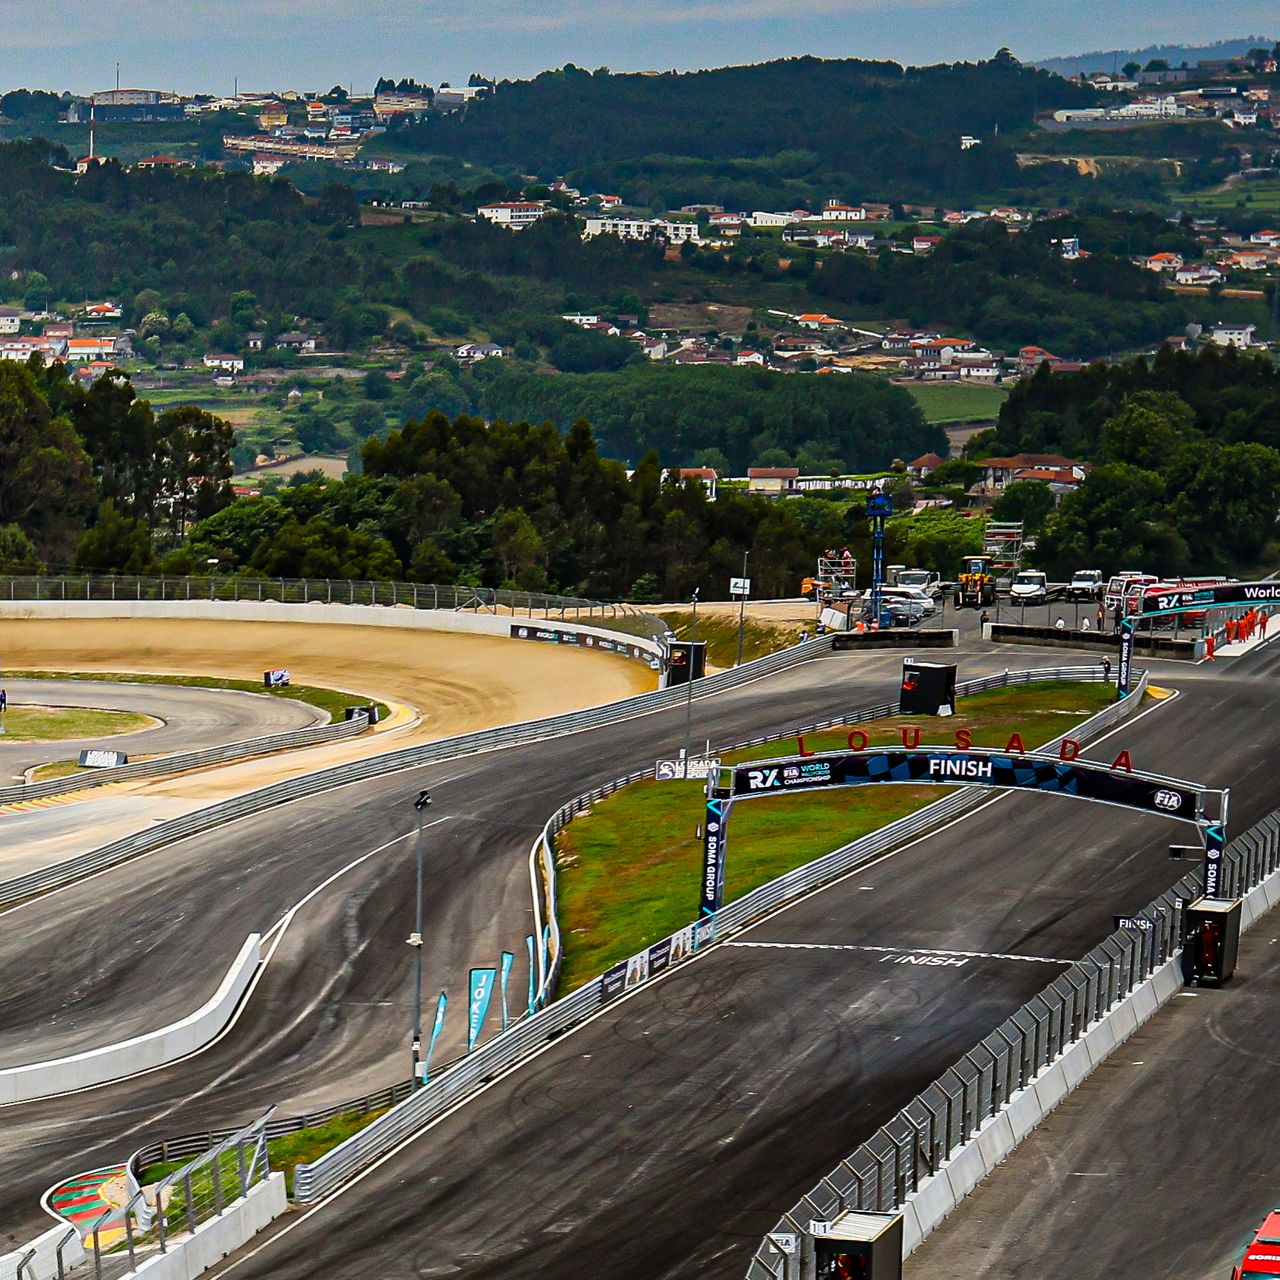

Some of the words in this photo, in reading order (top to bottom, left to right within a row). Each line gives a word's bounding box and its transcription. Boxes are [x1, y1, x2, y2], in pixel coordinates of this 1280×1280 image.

[1158, 594, 1180, 609] RX
[797, 727, 1133, 773] LOUSADA
[783, 768, 799, 778] FIA
[801, 763, 830, 772] WORLD
[929, 758, 993, 778] FINISH
[748, 768, 782, 789] RX
[1155, 790, 1181, 809] FIA
[706, 836, 717, 866] SOMA
[706, 866, 716, 900] GROUP
[1206, 863, 1216, 893] SOMA
[1119, 919, 1153, 930] FINSH
[879, 955, 969, 968] FINISH
[469, 974, 488, 1040] JOKER
